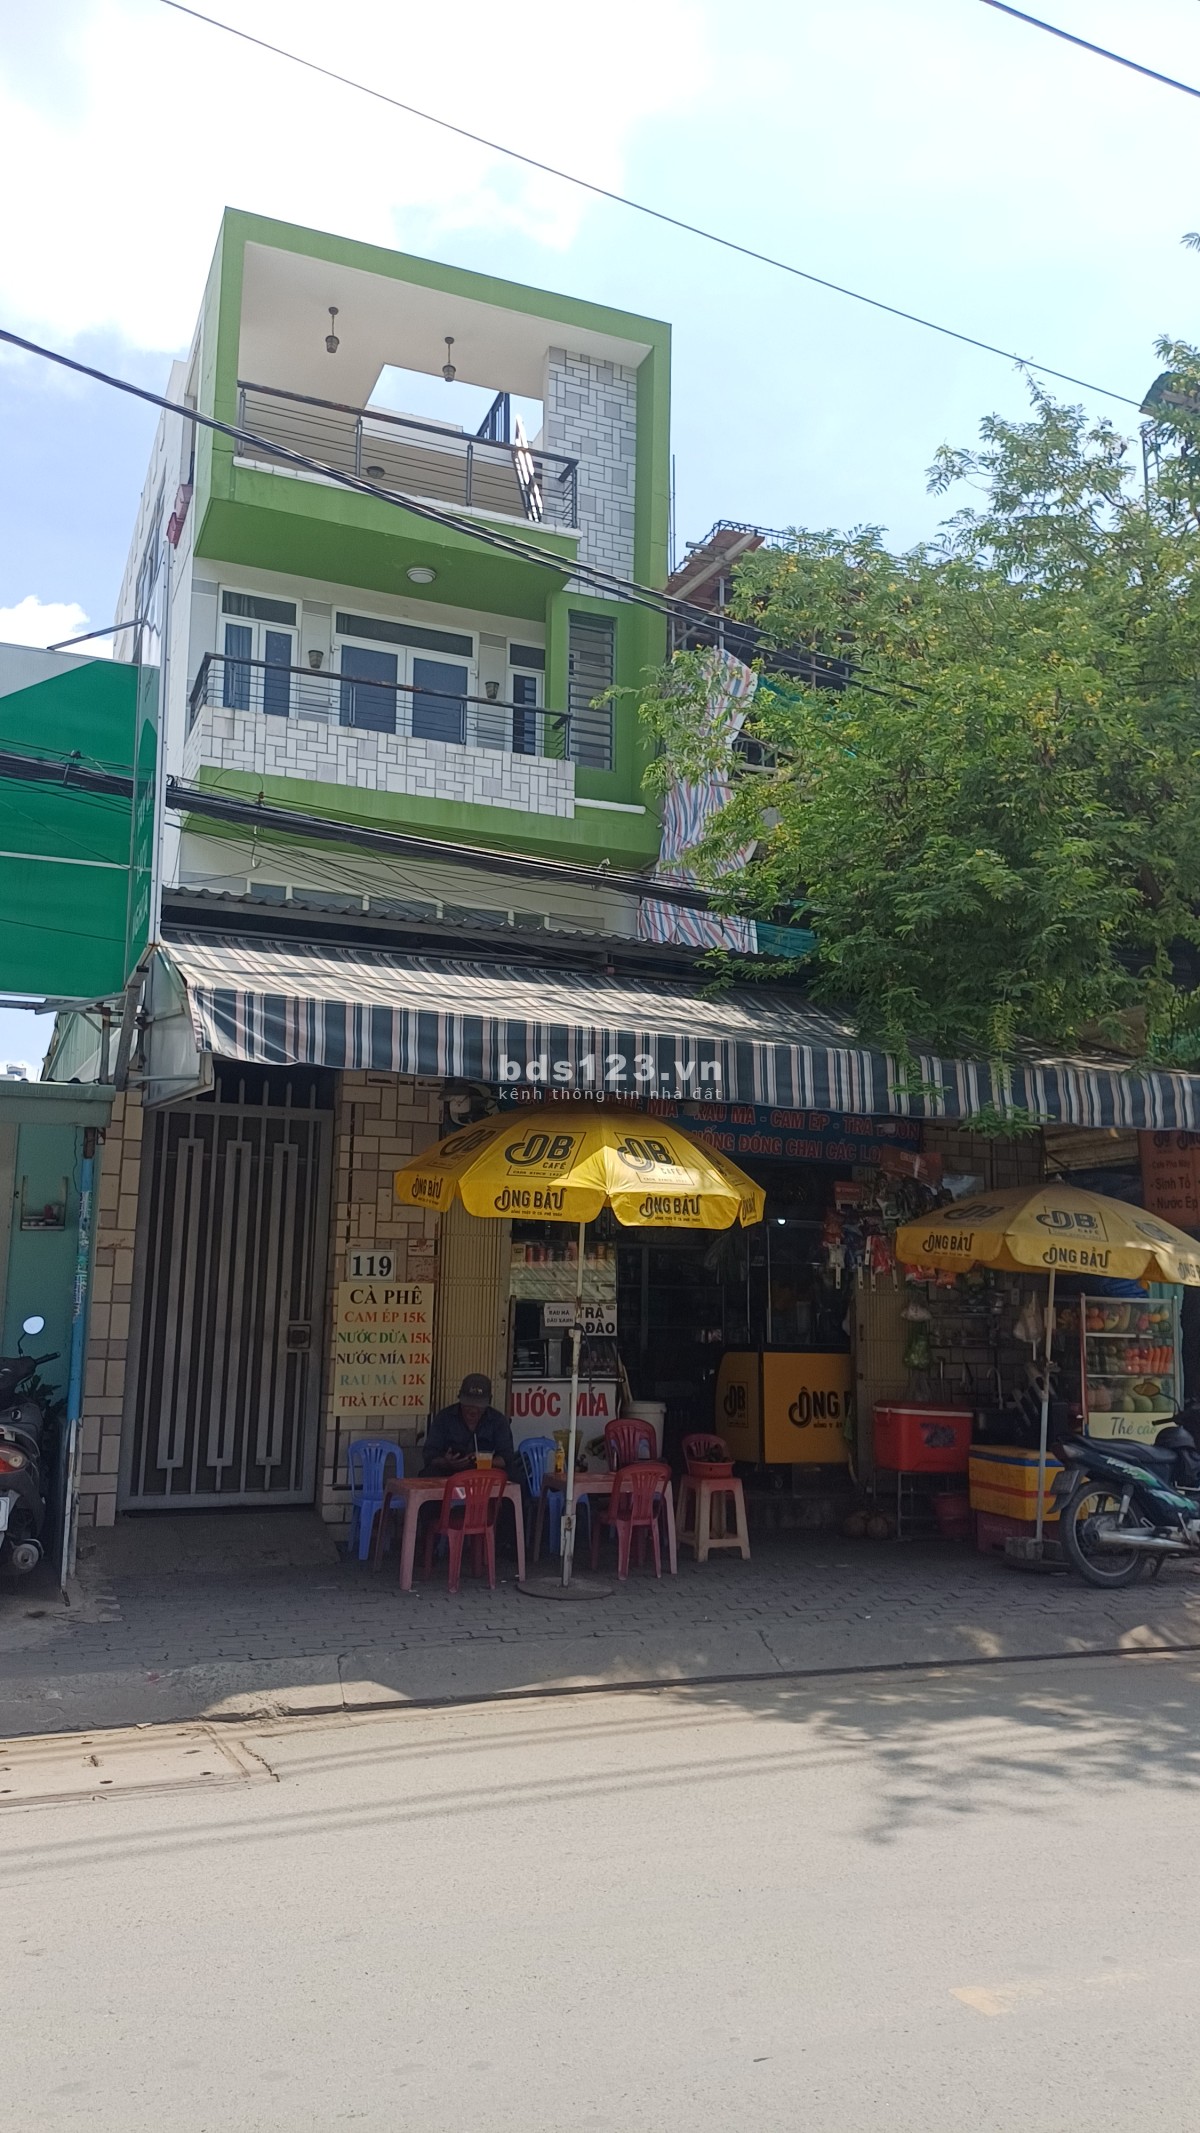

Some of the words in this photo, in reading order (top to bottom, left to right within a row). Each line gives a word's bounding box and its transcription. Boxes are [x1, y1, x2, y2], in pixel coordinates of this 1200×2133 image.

[770, 1109, 805, 1129] CAM
[739, 1131, 782, 1156] ĐÓNG
[786, 1138, 822, 1159] CHAI
[826, 1137, 857, 1161] CÁC
[542, 1161, 567, 1170] CAFÉ
[1155, 1177, 1177, 1190] Sinh
[494, 1185, 531, 1213] ÔNG
[639, 1193, 672, 1219] ÔNG
[922, 1231, 949, 1253] ÔNG
[1042, 1243, 1077, 1265] ÔNG
[352, 1255, 392, 1277] 119
[350, 1285, 378, 1305] CÀ
[384, 1285, 423, 1305] PHÊ
[344, 1311, 378, 1323] CAM
[382, 1308, 399, 1323] ÉP
[403, 1311, 427, 1323] 15K
[337, 1328, 377, 1344] NƯỚC
[379, 1328, 408, 1344] DỪA
[410, 1332, 432, 1344] 15K
[585, 1319, 616, 1334] ĐÀO
[336, 1350, 377, 1365] NƯỚC
[379, 1350, 406, 1365] MÍA
[409, 1353, 431, 1364] 12K
[340, 1374, 370, 1386] RAU
[402, 1374, 426, 1385] 12K
[339, 1392, 367, 1407] TRÀ
[370, 1392, 399, 1407] TÁC
[402, 1395, 424, 1406] 12K
[788, 1386, 840, 1428] ÔNG
